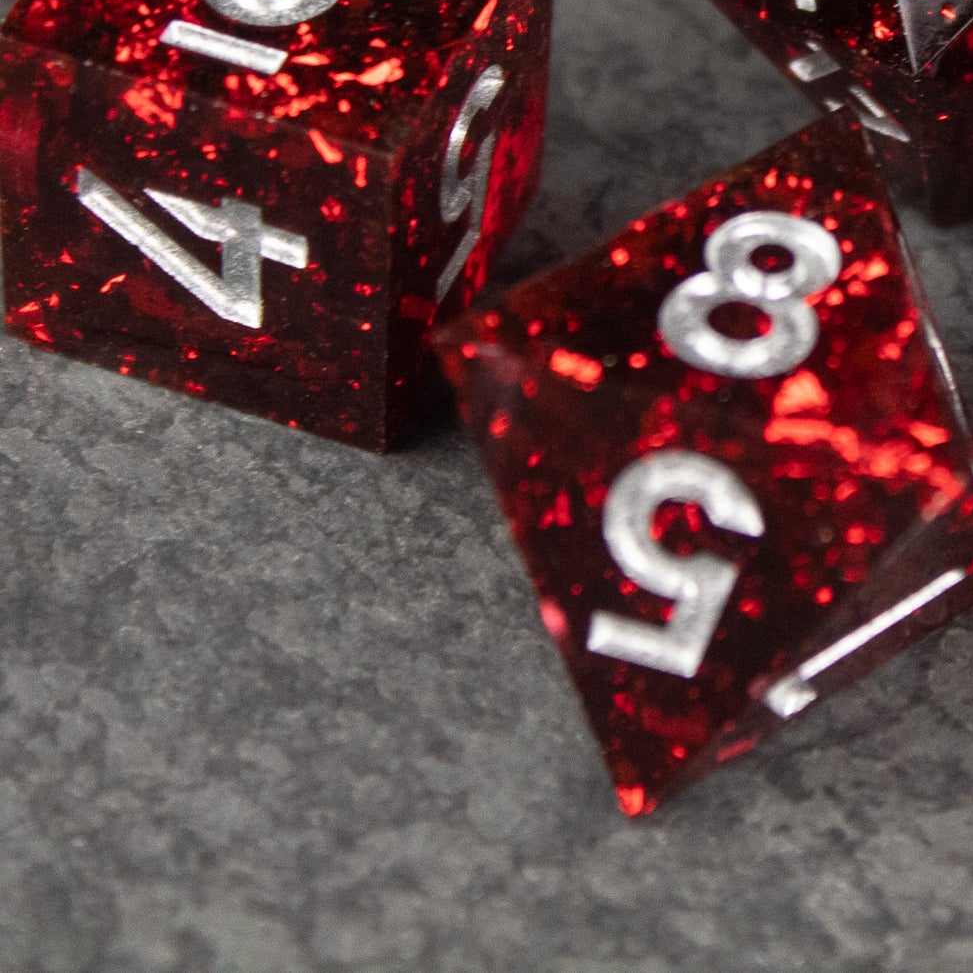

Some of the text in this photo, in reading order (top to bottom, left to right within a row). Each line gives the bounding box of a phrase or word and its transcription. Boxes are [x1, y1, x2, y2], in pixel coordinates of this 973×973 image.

[77, 167, 309, 329] 4
[658, 210, 841, 379] 8
[586, 449, 765, 679] 5
